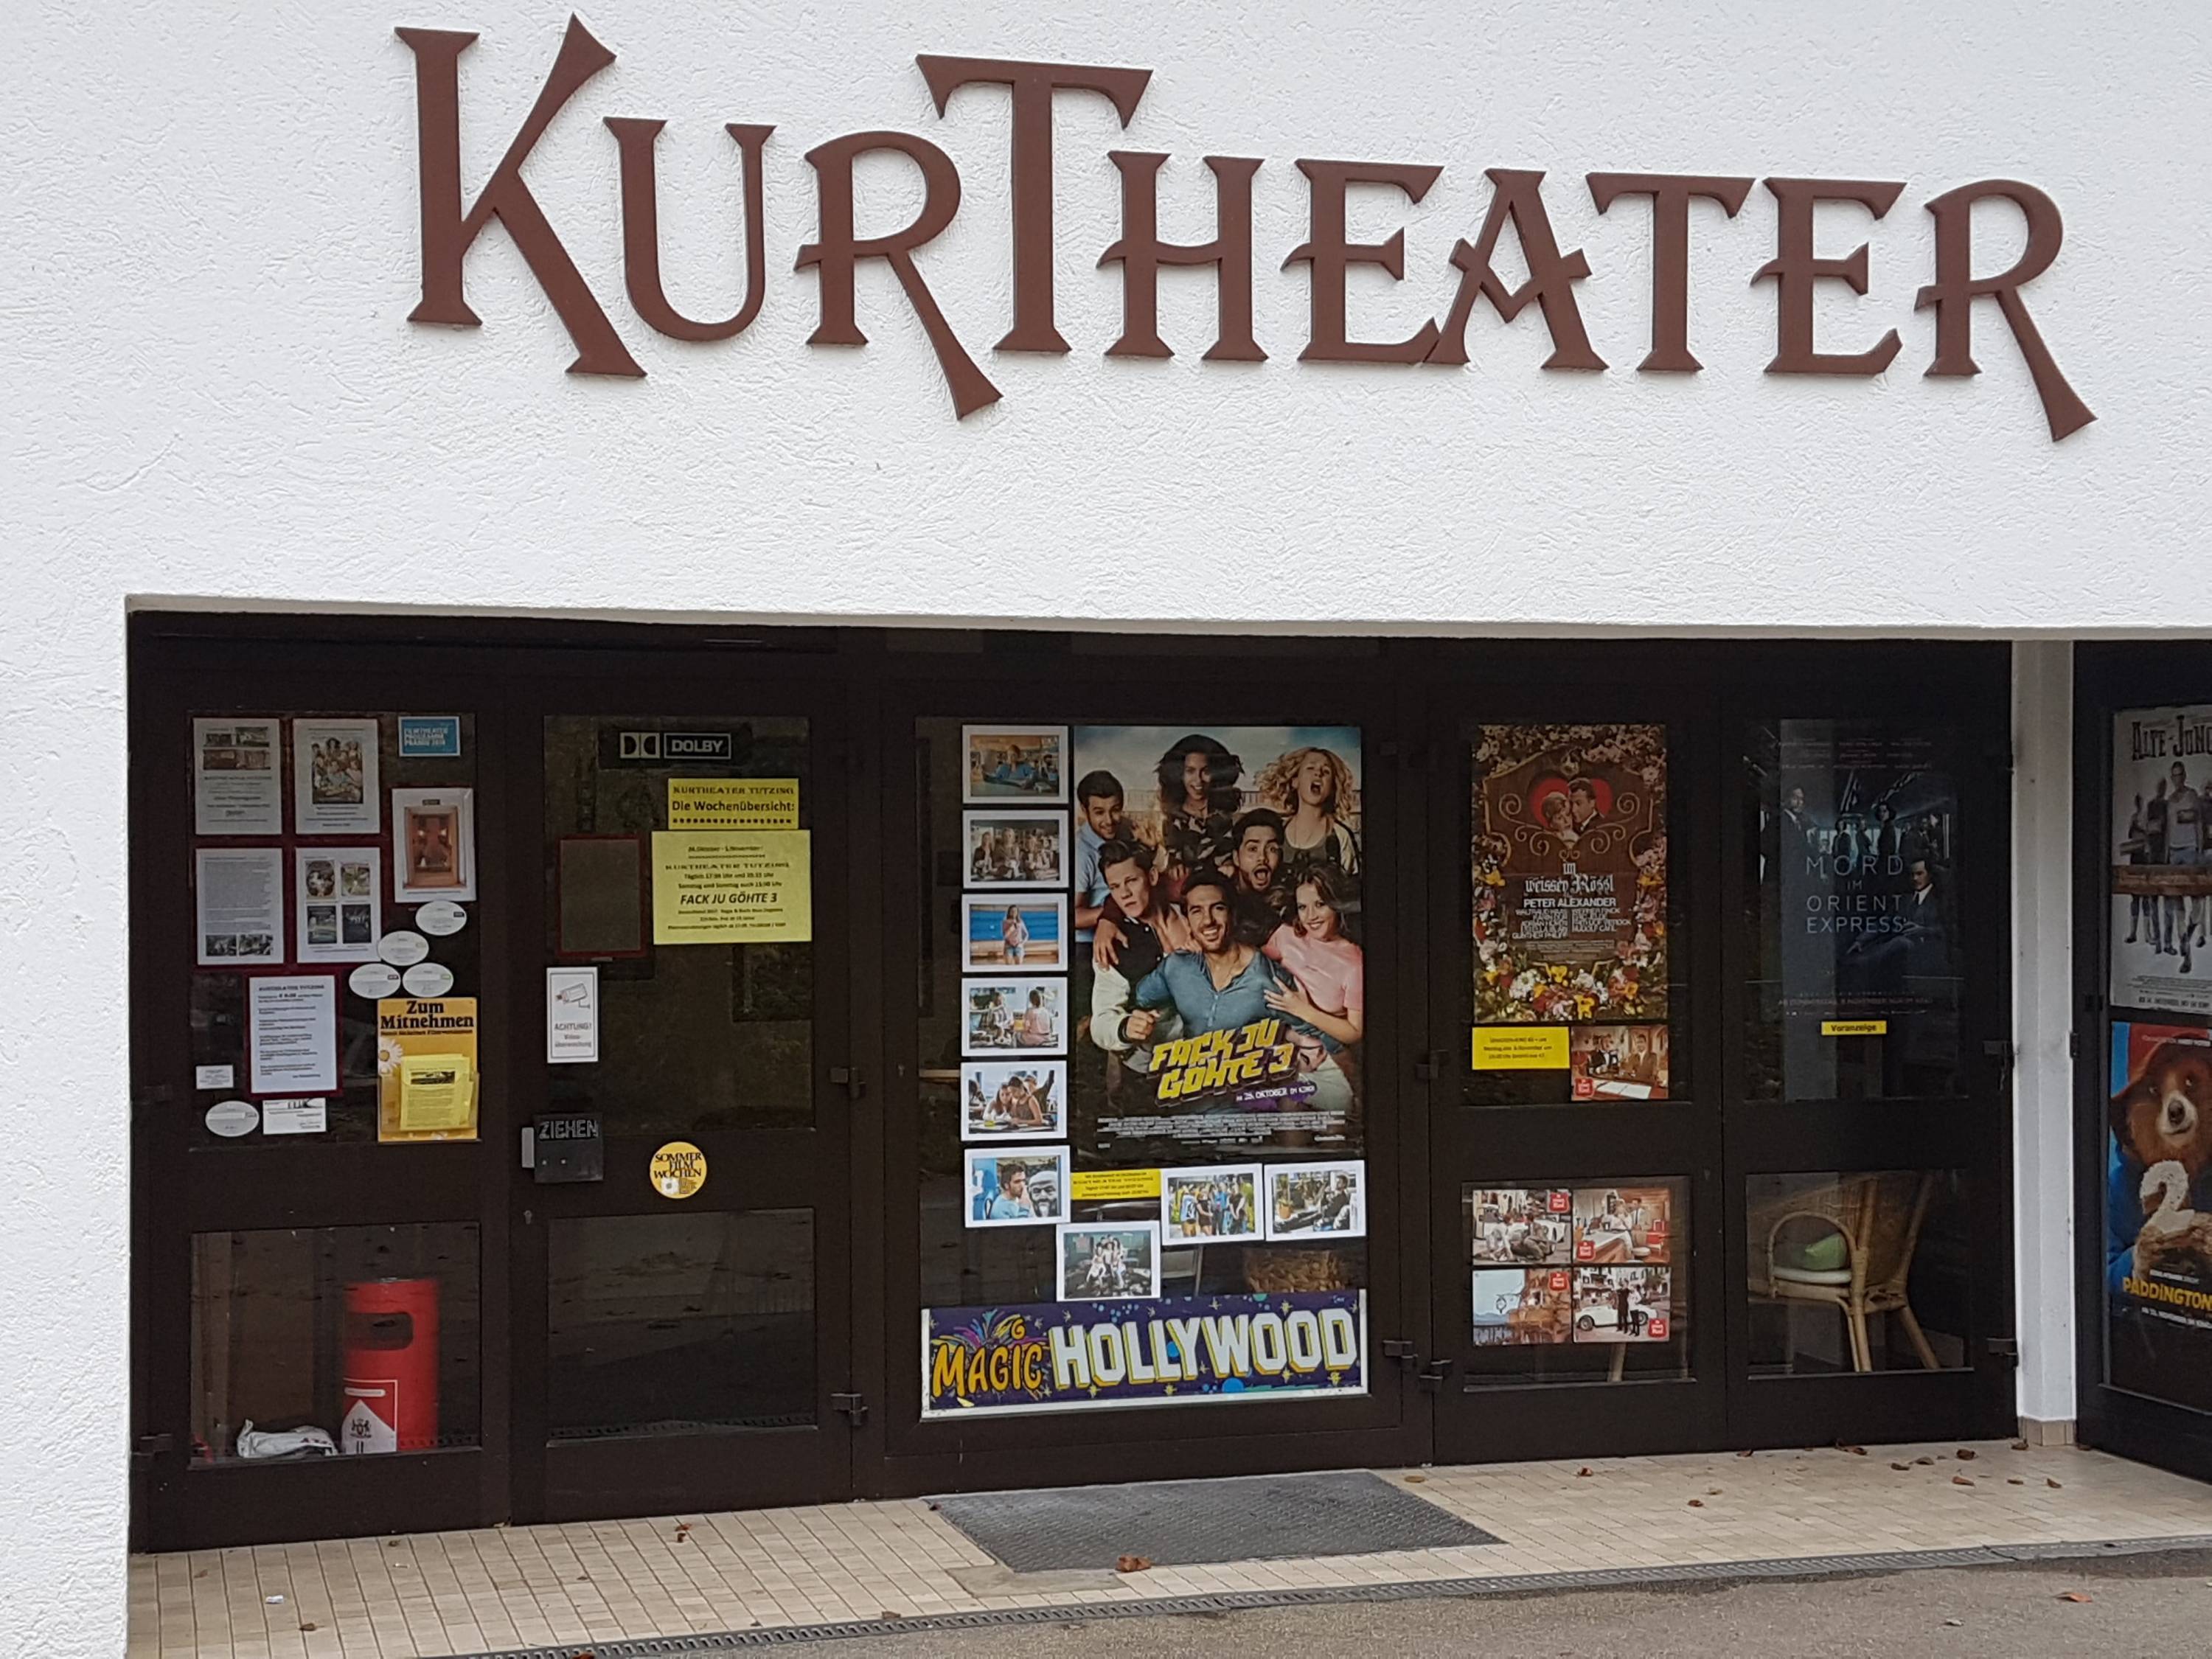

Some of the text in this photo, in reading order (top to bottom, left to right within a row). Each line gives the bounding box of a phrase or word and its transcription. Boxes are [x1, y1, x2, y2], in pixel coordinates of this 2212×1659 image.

[394, 14, 2096, 443] KURTHEATER
[672, 739, 723, 753] DOLBY
[672, 800, 794, 812] Die Wochenübersicht:
[1806, 855, 1904, 876] MORD
[1847, 880, 1863, 890] IM
[681, 891, 778, 905] FACK JU GÖHTE 3
[1524, 897, 1616, 908] PETER ALEXANDER
[1806, 894, 1903, 912] ORIENT
[1806, 916, 1904, 933] EXPRESS
[406, 1001, 445, 1015] Zum
[381, 1014, 474, 1030] Mitnehmen
[1148, 1018, 1280, 1072] FACK JU
[1268, 1043, 1295, 1074] 3
[1255, 1087, 1288, 1099] OKTOBER
[539, 1120, 599, 1140] ZIEHEN
[655, 1152, 703, 1163] SOMMER
[653, 1168, 702, 1179] WOCHEN
[932, 1307, 1359, 1399] MAGIC HOLLYWOOD
